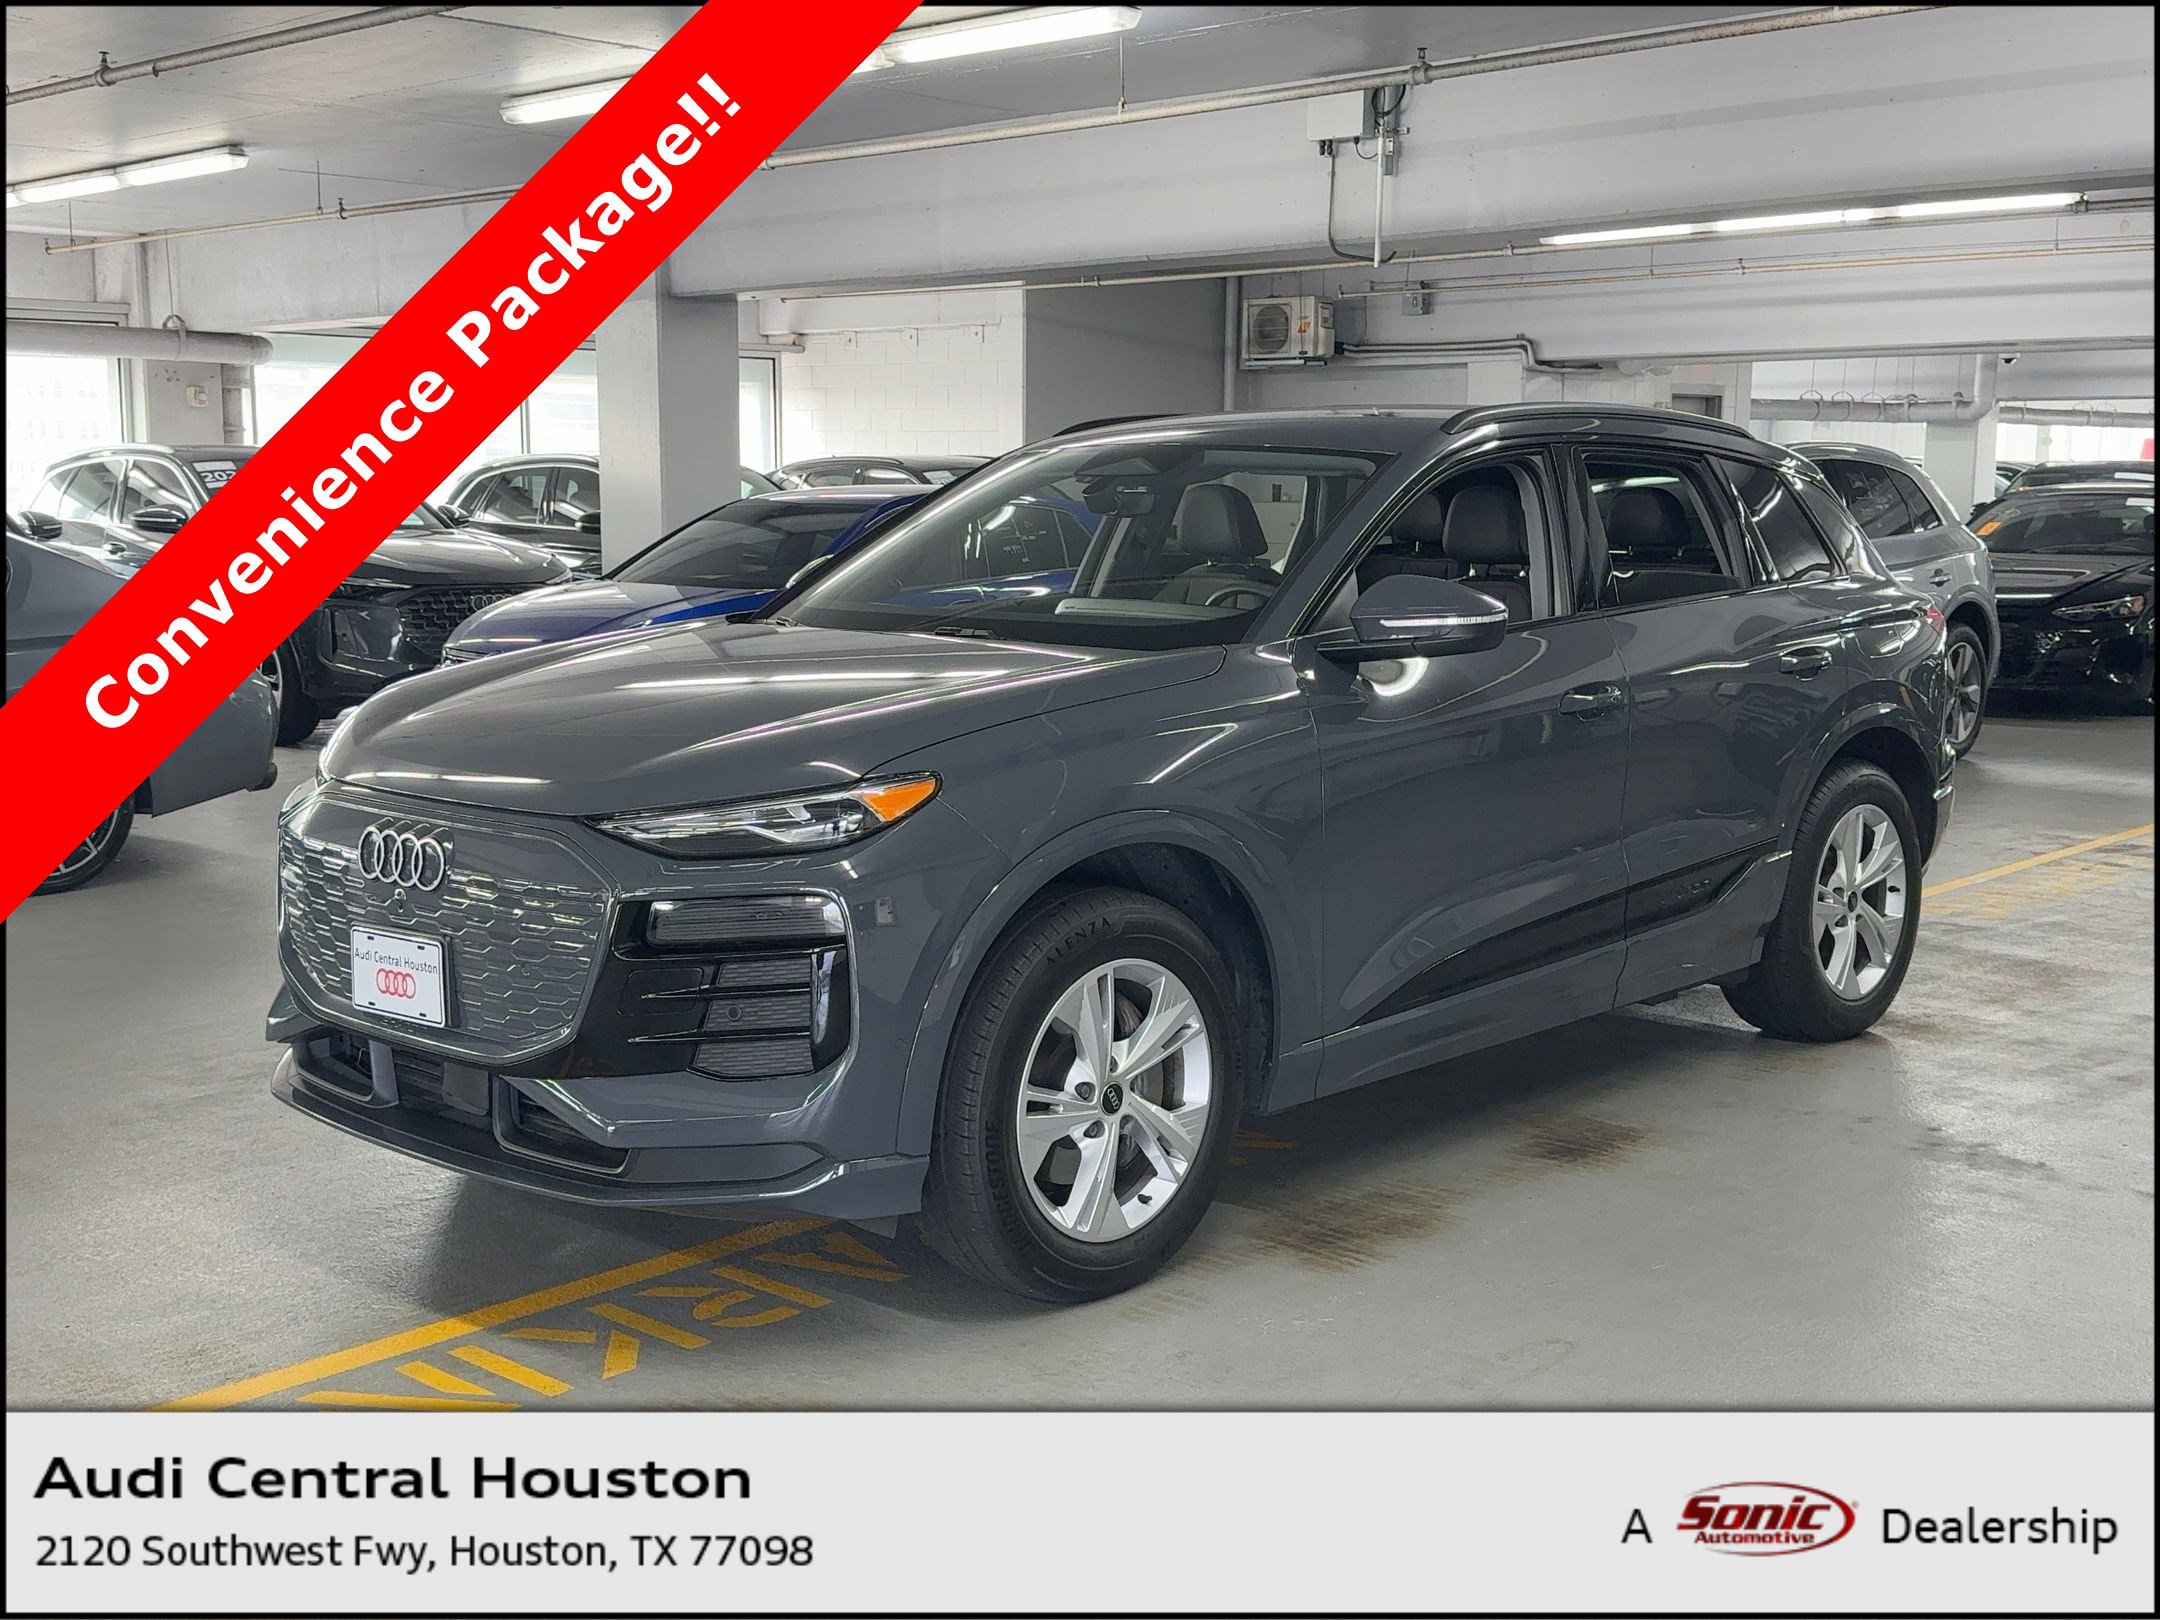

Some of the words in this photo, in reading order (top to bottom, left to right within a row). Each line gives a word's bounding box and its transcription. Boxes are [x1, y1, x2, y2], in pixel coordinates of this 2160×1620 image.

[1046, 917, 1112, 965] ALENZA
[354, 947, 373, 961] Audi
[373, 951, 403, 968] Central
[404, 957, 438, 975] Houston
